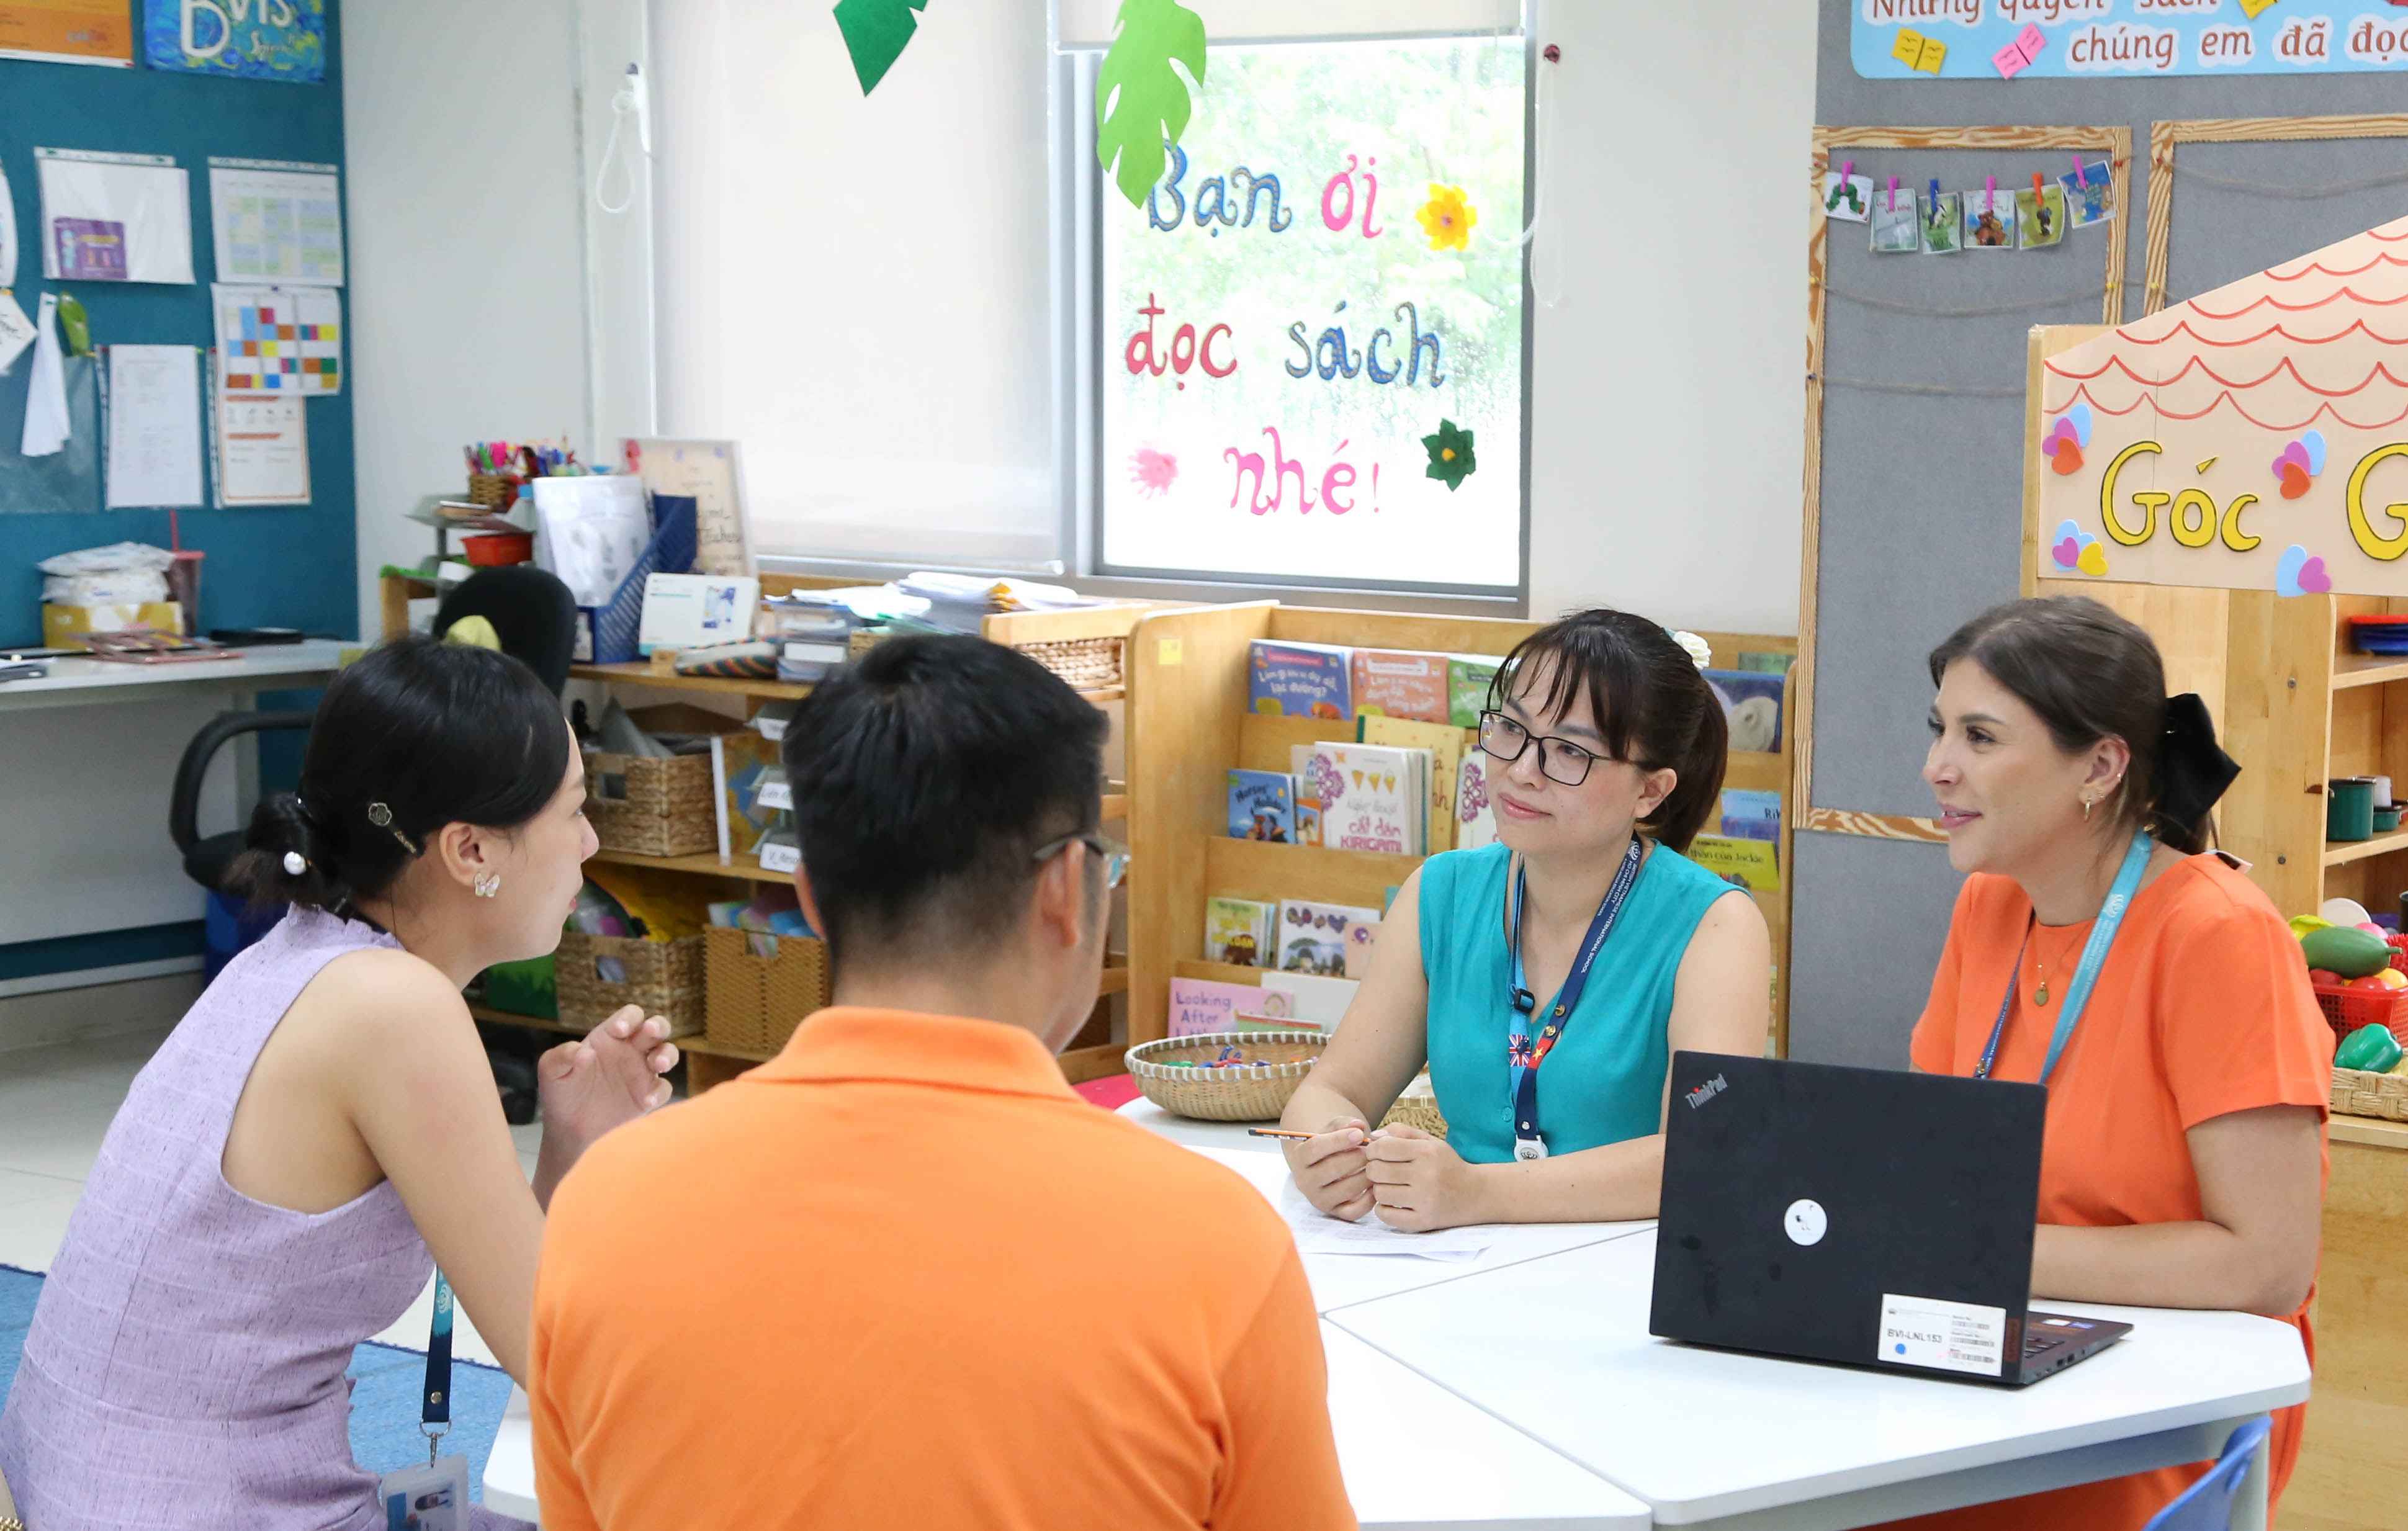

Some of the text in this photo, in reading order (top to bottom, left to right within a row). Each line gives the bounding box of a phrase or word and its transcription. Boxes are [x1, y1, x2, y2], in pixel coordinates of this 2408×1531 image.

[2072, 26, 2173, 68] chúng
[2201, 32, 2251, 56] em
[2281, 22, 2325, 56] đã
[1125, 293, 1445, 392] đọc sách
[2100, 440, 2262, 552] Góc
[1175, 991, 1231, 1013] Looking
[1180, 1008, 1220, 1023] After
[1684, 1072, 1728, 1109] ThinkPad
